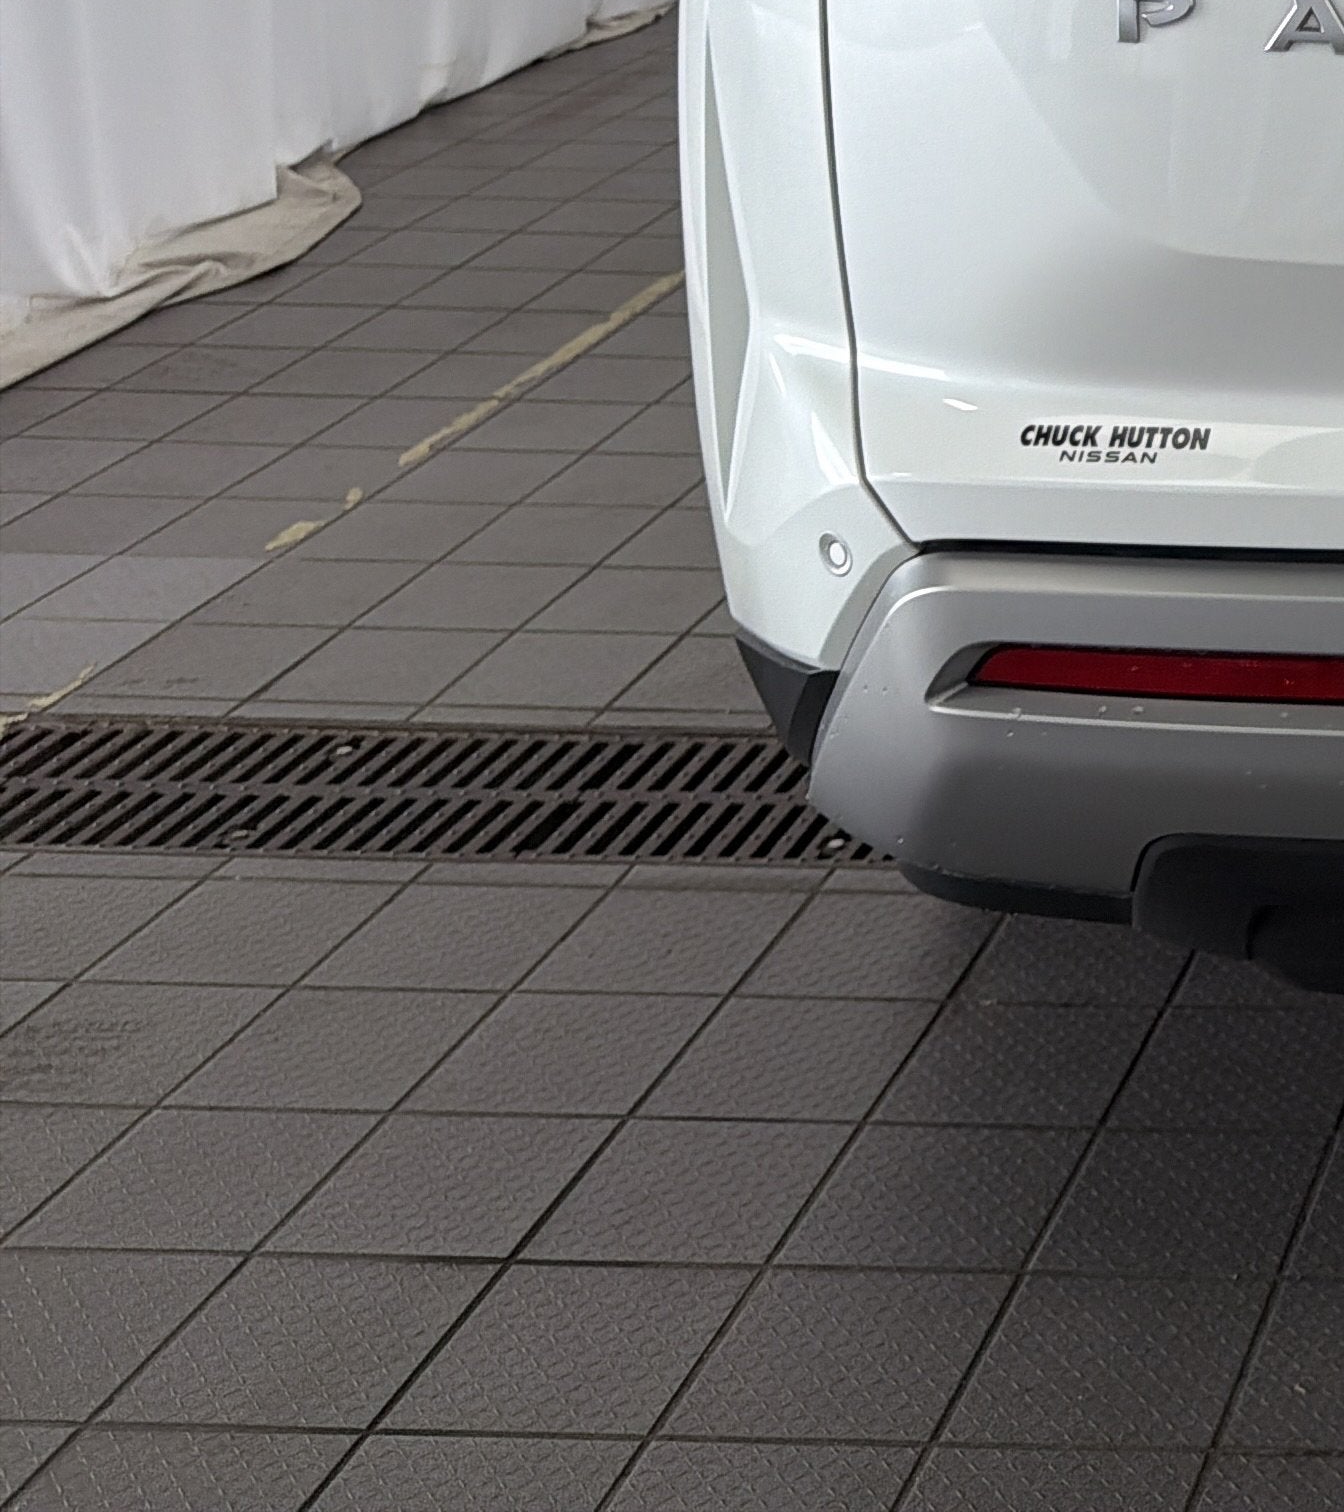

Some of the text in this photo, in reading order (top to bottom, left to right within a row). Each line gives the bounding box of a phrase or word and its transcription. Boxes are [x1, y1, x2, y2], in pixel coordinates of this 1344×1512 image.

[1020, 424, 1211, 450] CHUCK HUTTON
[1059, 450, 1158, 464] NISSAN
